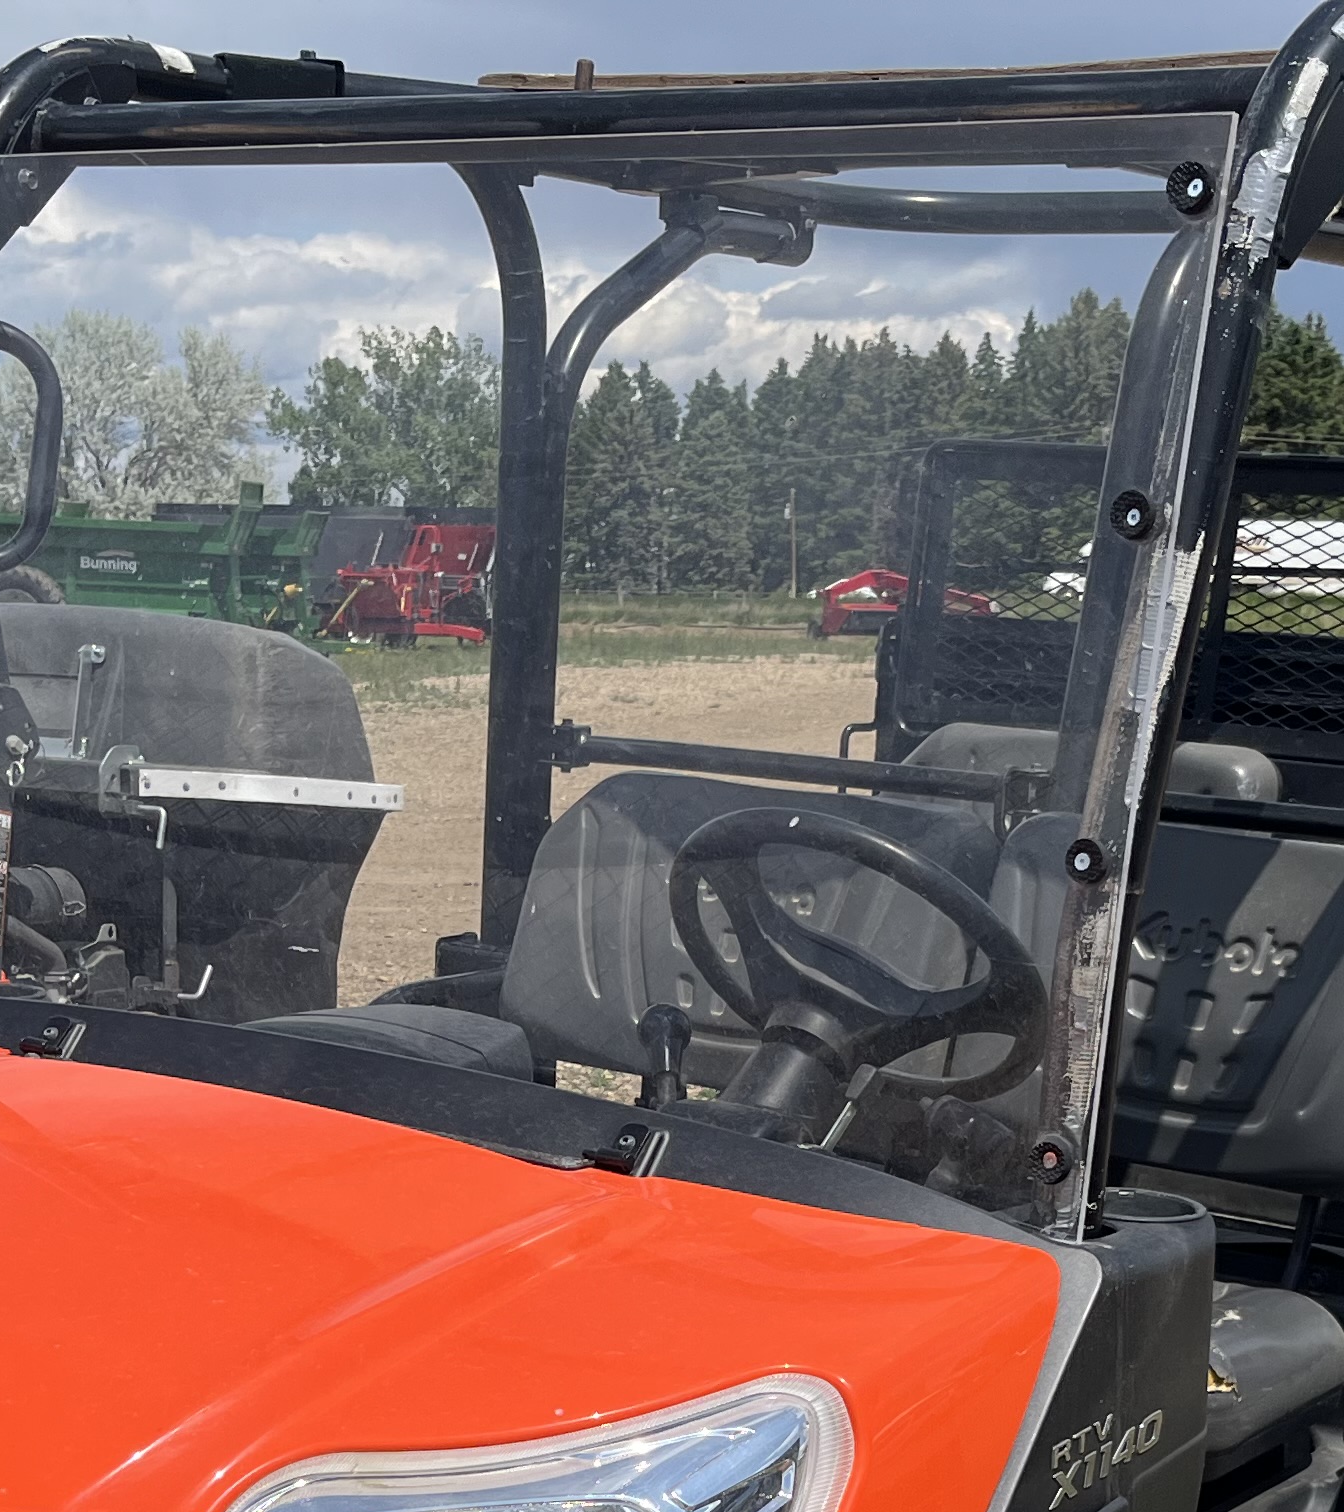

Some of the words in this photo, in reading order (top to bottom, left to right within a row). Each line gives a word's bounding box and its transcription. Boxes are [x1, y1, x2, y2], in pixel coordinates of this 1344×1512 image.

[80, 556, 138, 574] Bunning
[1048, 1409, 1163, 1511] X1140
[1051, 1413, 1114, 1470] RTV
